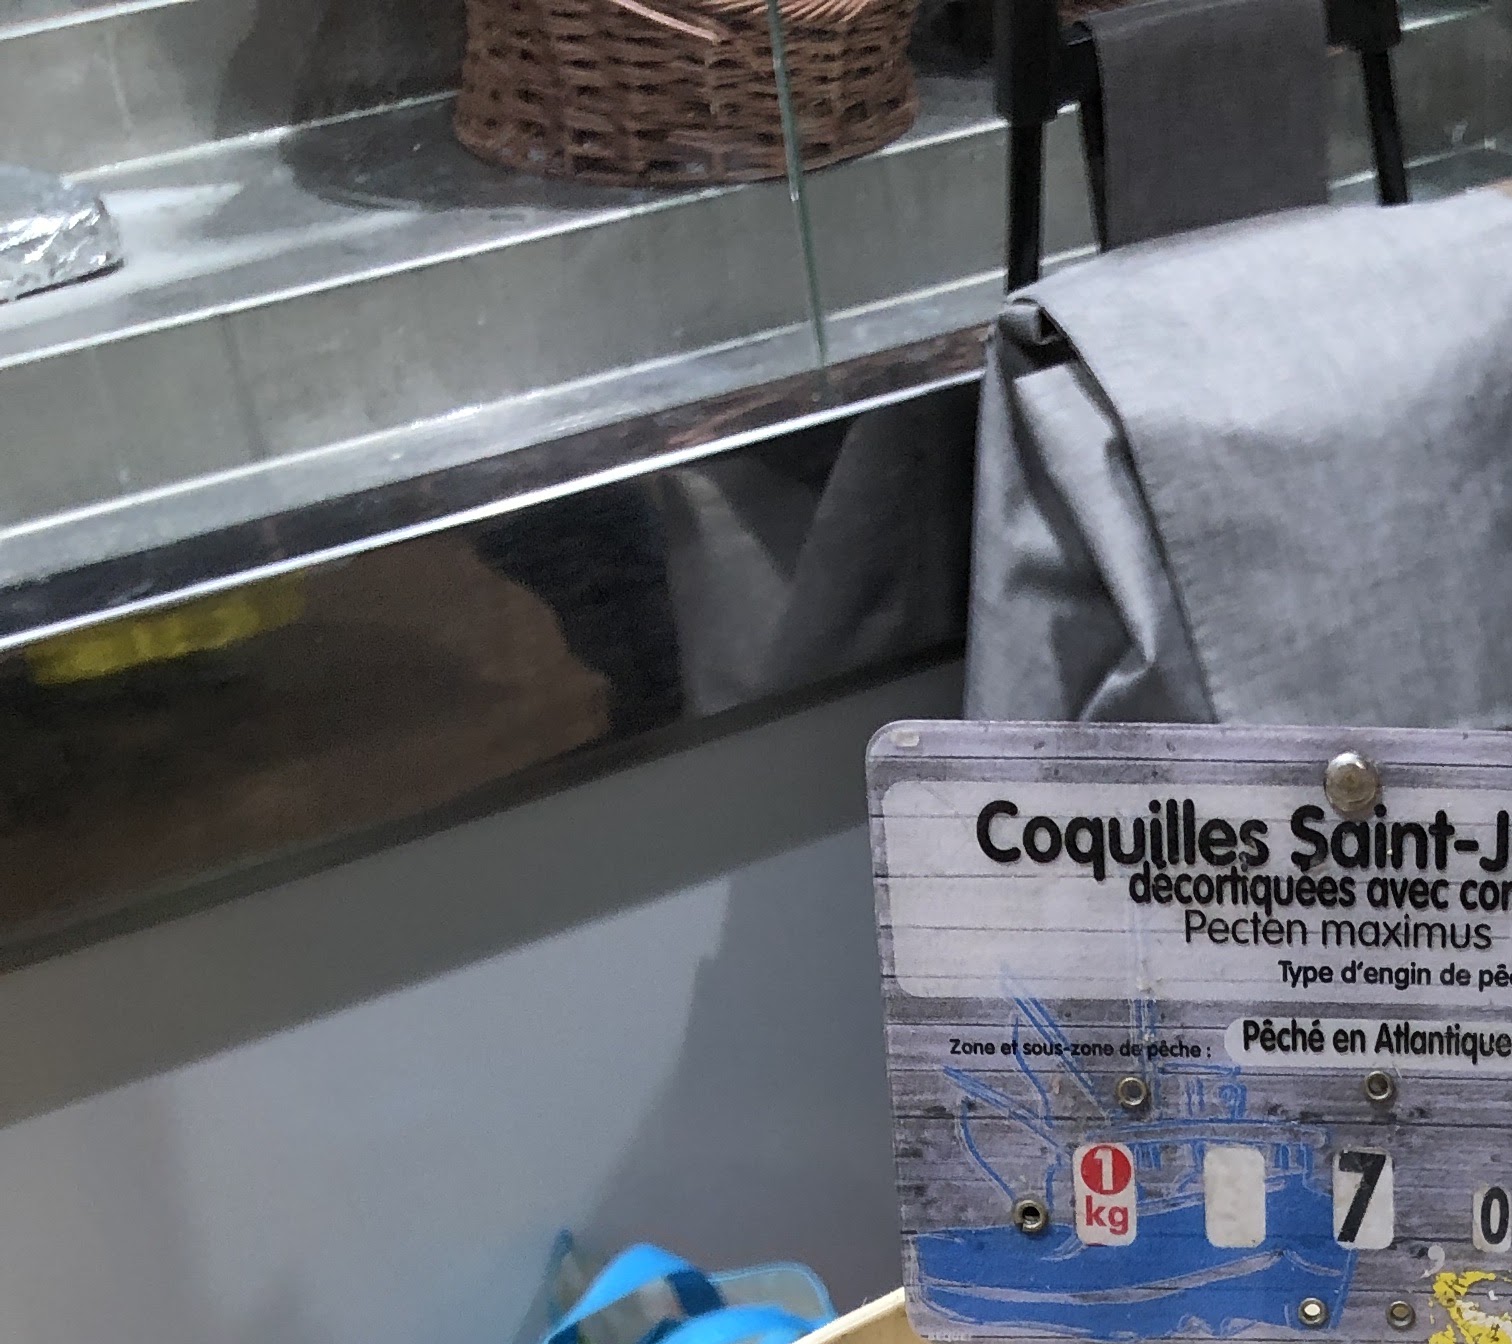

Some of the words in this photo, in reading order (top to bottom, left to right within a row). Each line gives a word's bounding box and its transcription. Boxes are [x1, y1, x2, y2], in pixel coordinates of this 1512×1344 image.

[975, 798, 1269, 881] Coquilles
[1366, 876, 1449, 910] avec
[1184, 909, 1308, 945] Pecten
[1321, 913, 1493, 950] maximus
[1278, 960, 1333, 988] Type
[1341, 960, 1430, 990] d'engin
[1439, 961, 1472, 987] de
[949, 1038, 996, 1056] Zone
[1000, 1039, 1018, 1056] et
[1022, 1041, 1115, 1058] sous-zone
[1119, 1040, 1141, 1058] de
[1146, 1040, 1202, 1061] pêche
[1242, 1019, 1325, 1055] Pêché
[1331, 1030, 1367, 1055] en
[1375, 1022, 1512, 1060] Atlantique
[1092, 1148, 1117, 1192] 1
[1084, 1195, 1130, 1235] kg
